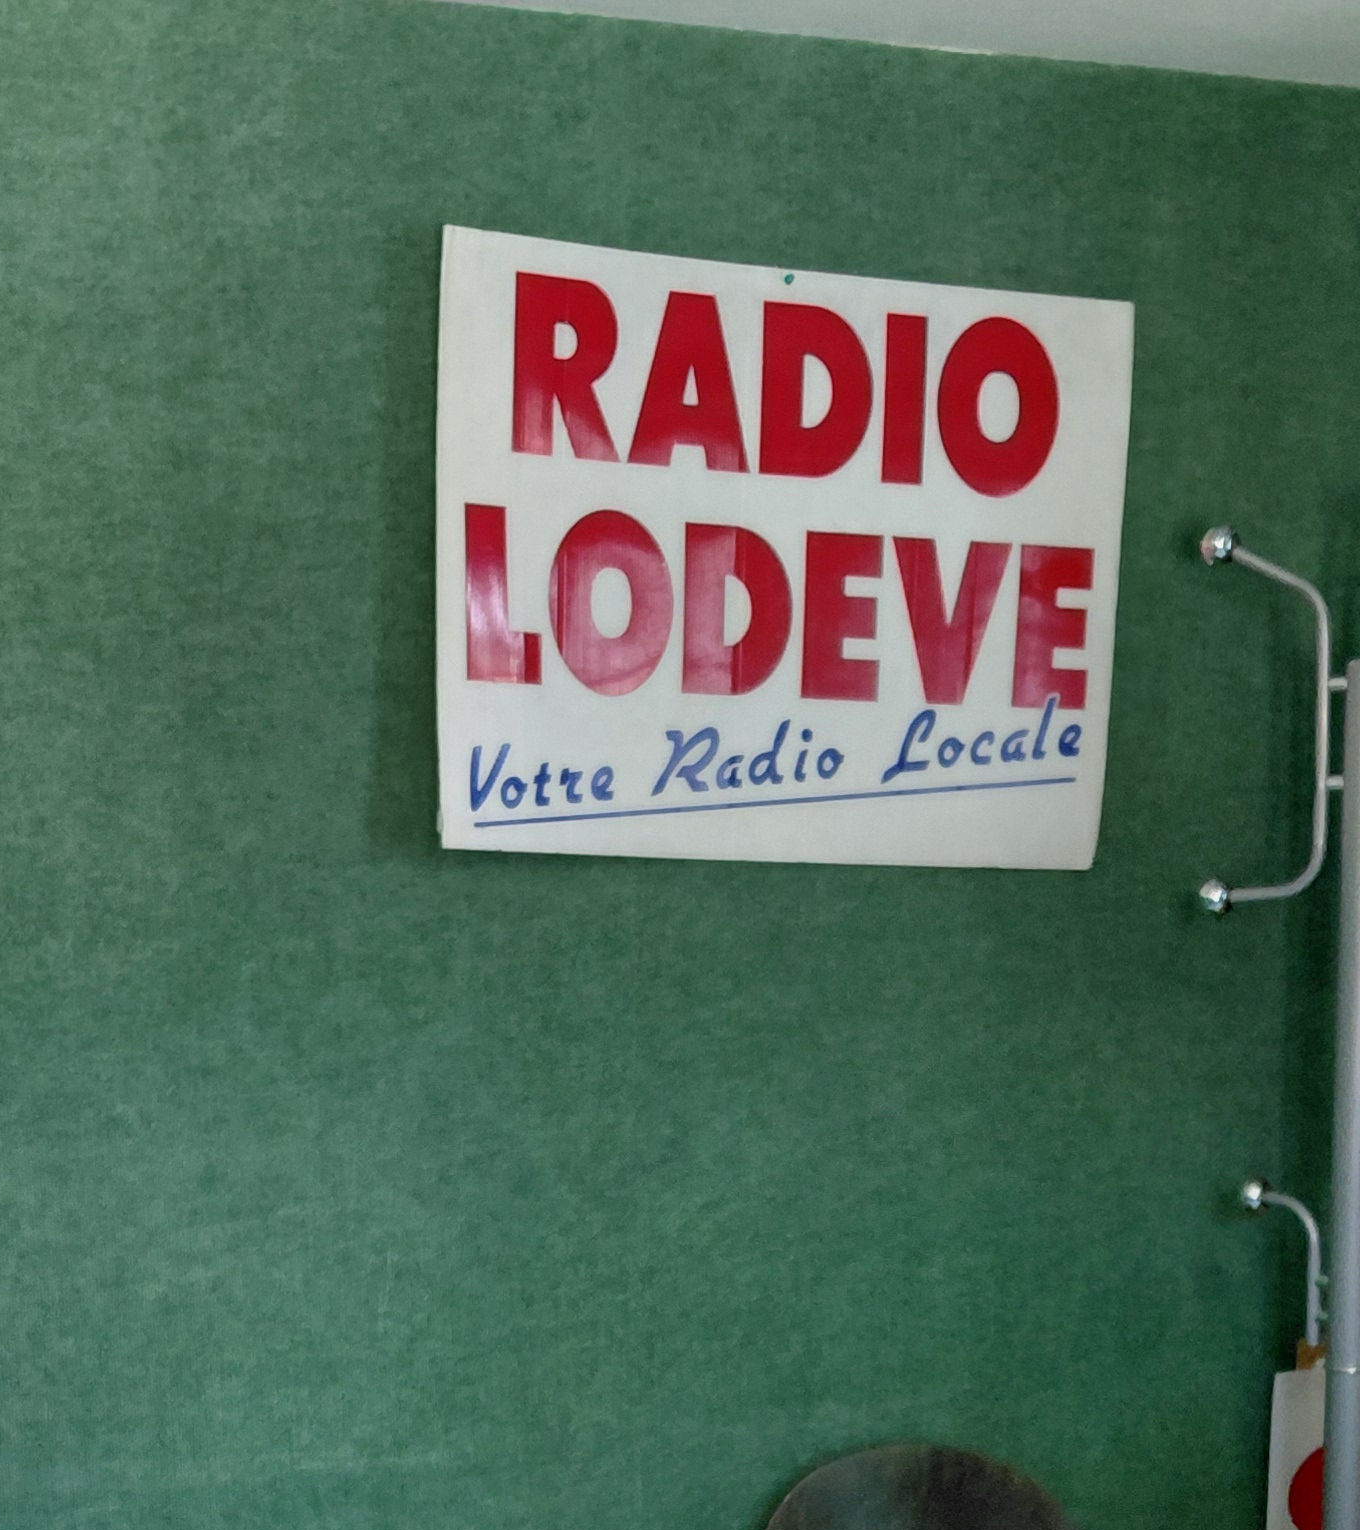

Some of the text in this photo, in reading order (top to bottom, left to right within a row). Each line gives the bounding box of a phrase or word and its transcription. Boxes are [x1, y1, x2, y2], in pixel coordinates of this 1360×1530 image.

[511, 271, 1059, 498] RADIO
[464, 503, 1095, 710] LODEVE
[469, 697, 1082, 812] Votre Radio Locale
